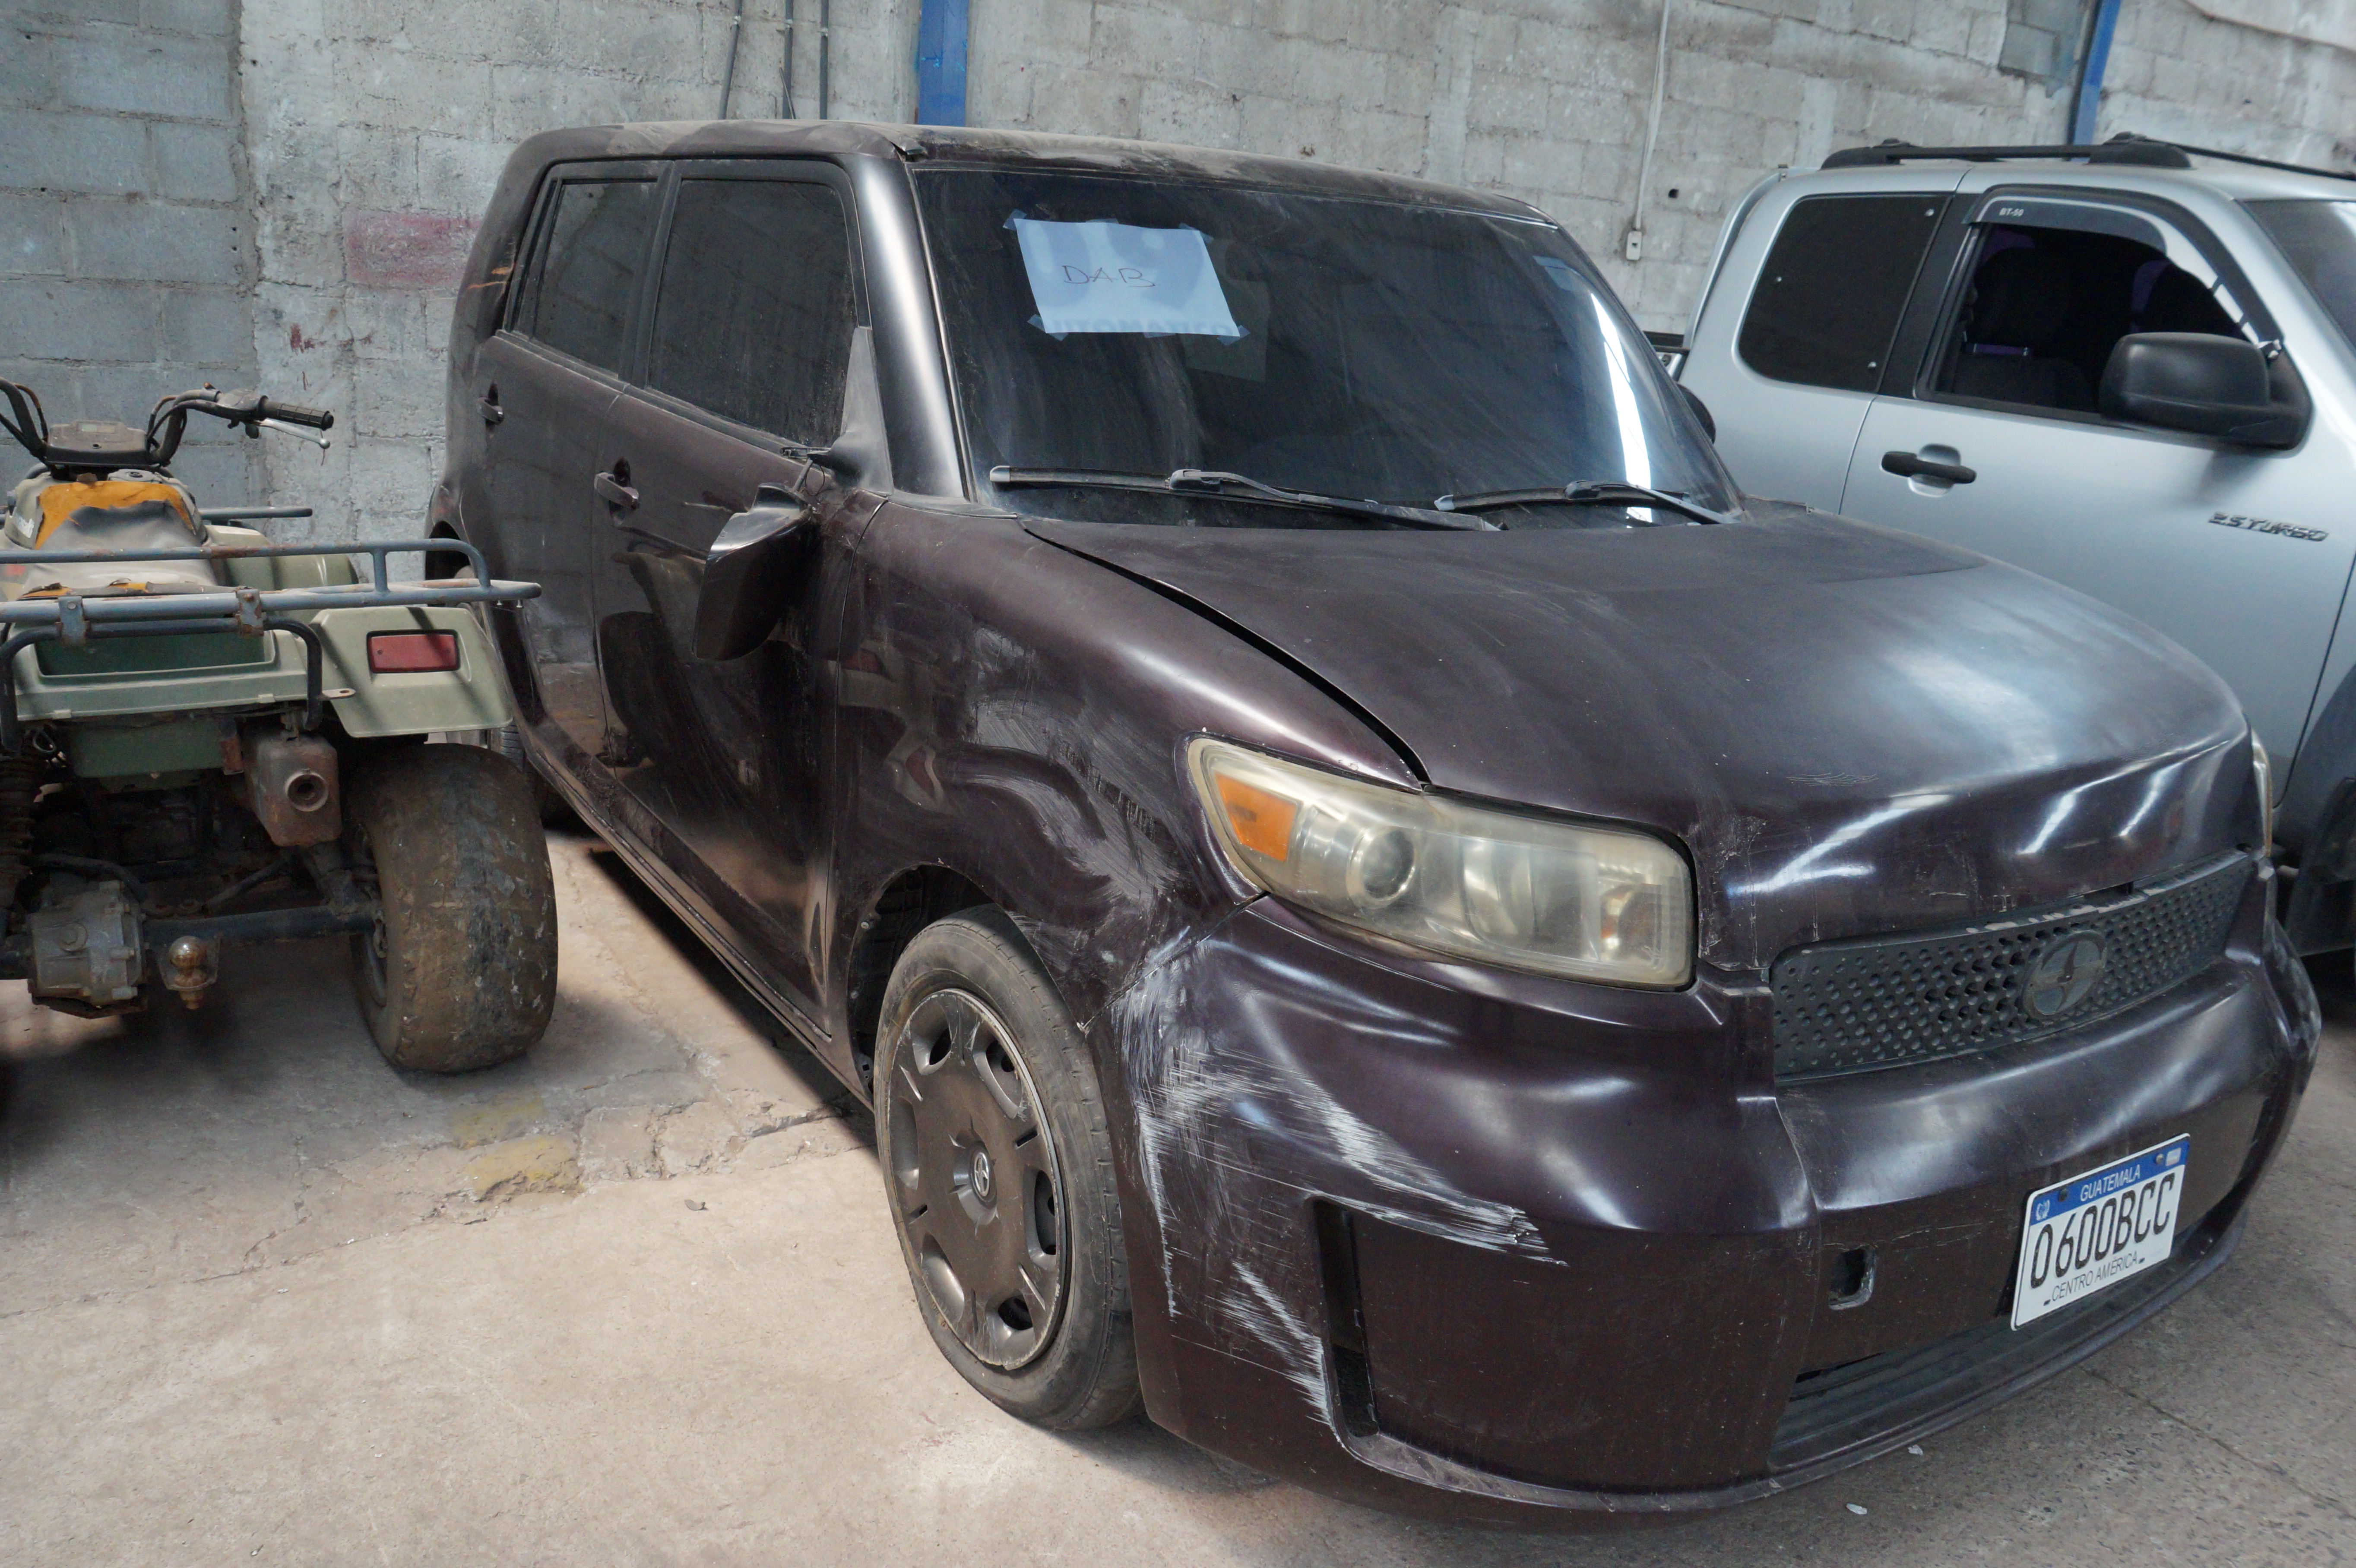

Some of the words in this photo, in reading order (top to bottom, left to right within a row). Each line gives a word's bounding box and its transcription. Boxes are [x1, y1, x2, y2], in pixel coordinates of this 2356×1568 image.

[1062, 265, 1156, 288] DAB
[2247, 519, 2330, 542] TURBO
[2080, 1164, 2141, 1201] GUATEMALA
[2052, 1270, 2093, 1302] CENTRO
